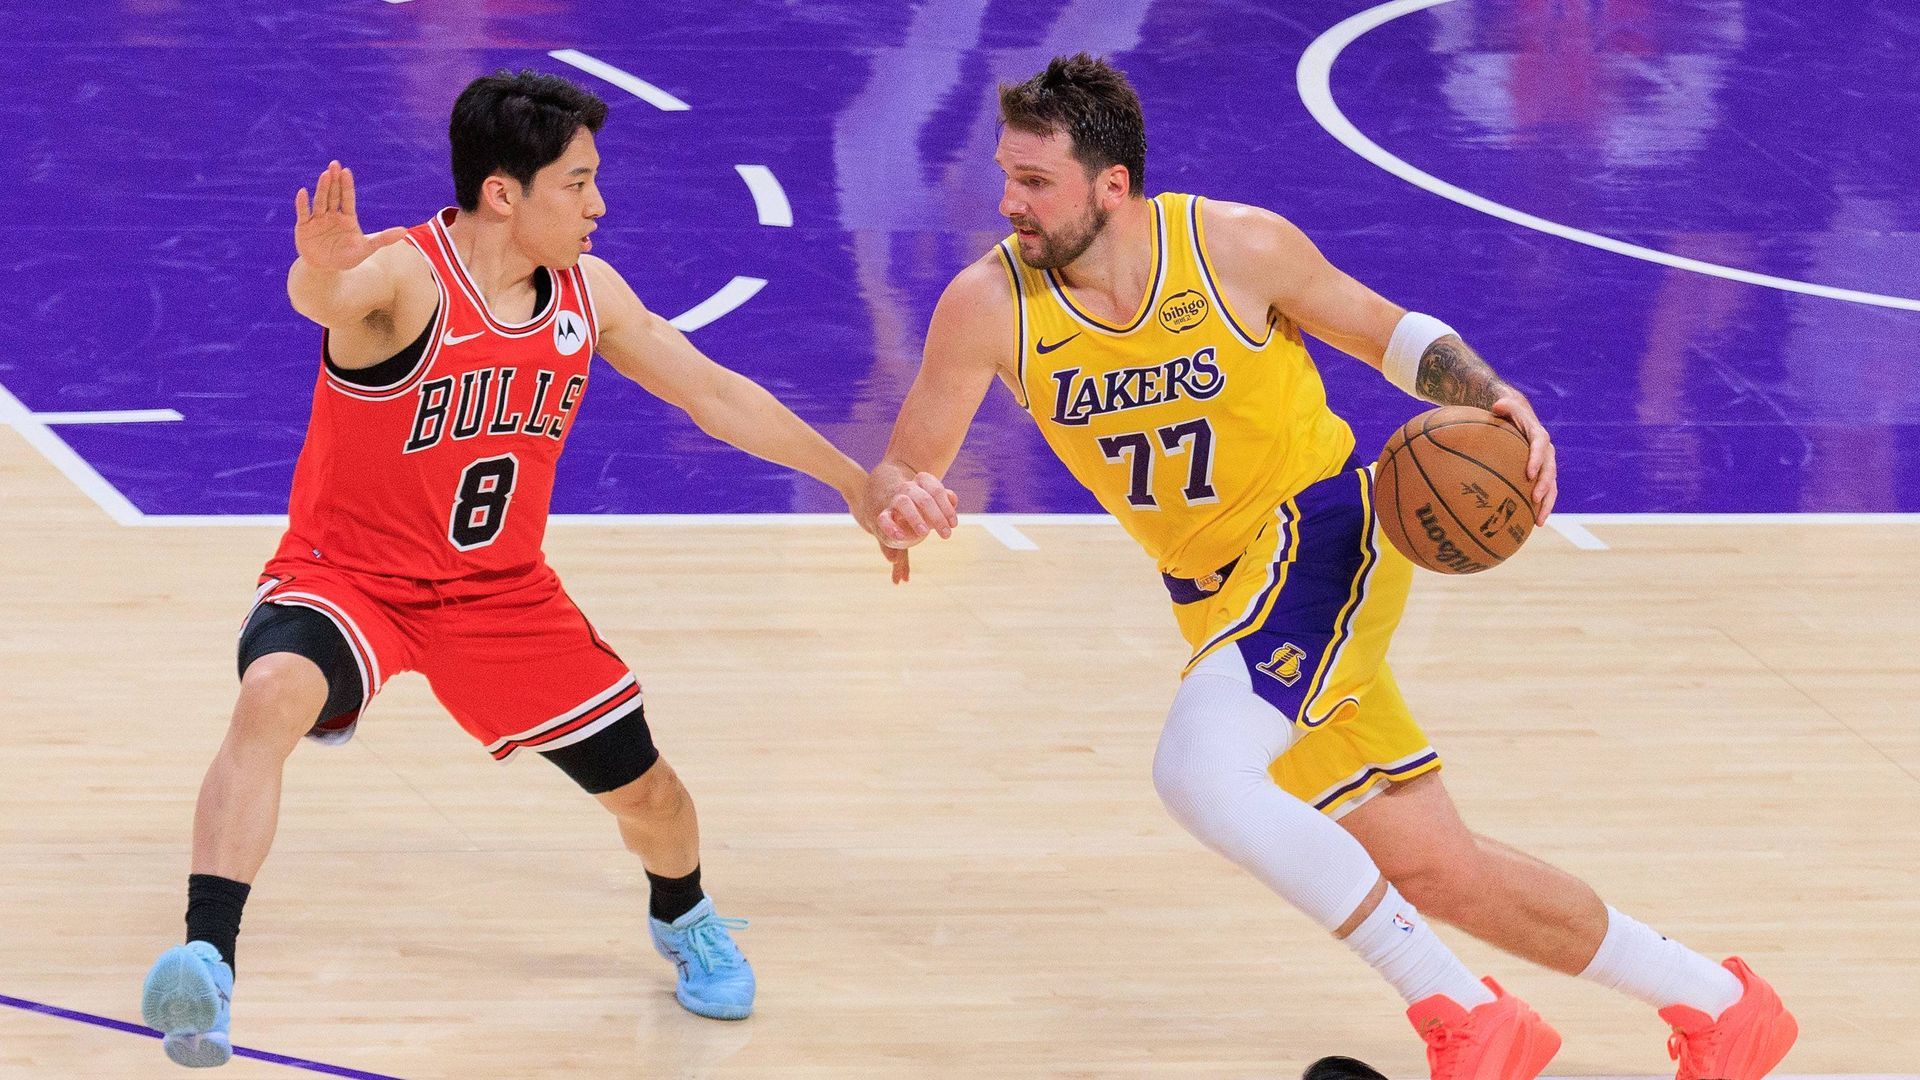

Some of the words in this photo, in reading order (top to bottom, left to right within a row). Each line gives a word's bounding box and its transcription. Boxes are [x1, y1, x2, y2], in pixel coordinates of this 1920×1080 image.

[1162, 300, 1205, 322] bibigo
[402, 367, 588, 454] BULLS
[1050, 346, 1226, 426] LAKERS
[448, 452, 519, 552] 8
[1096, 416, 1219, 512] 77
